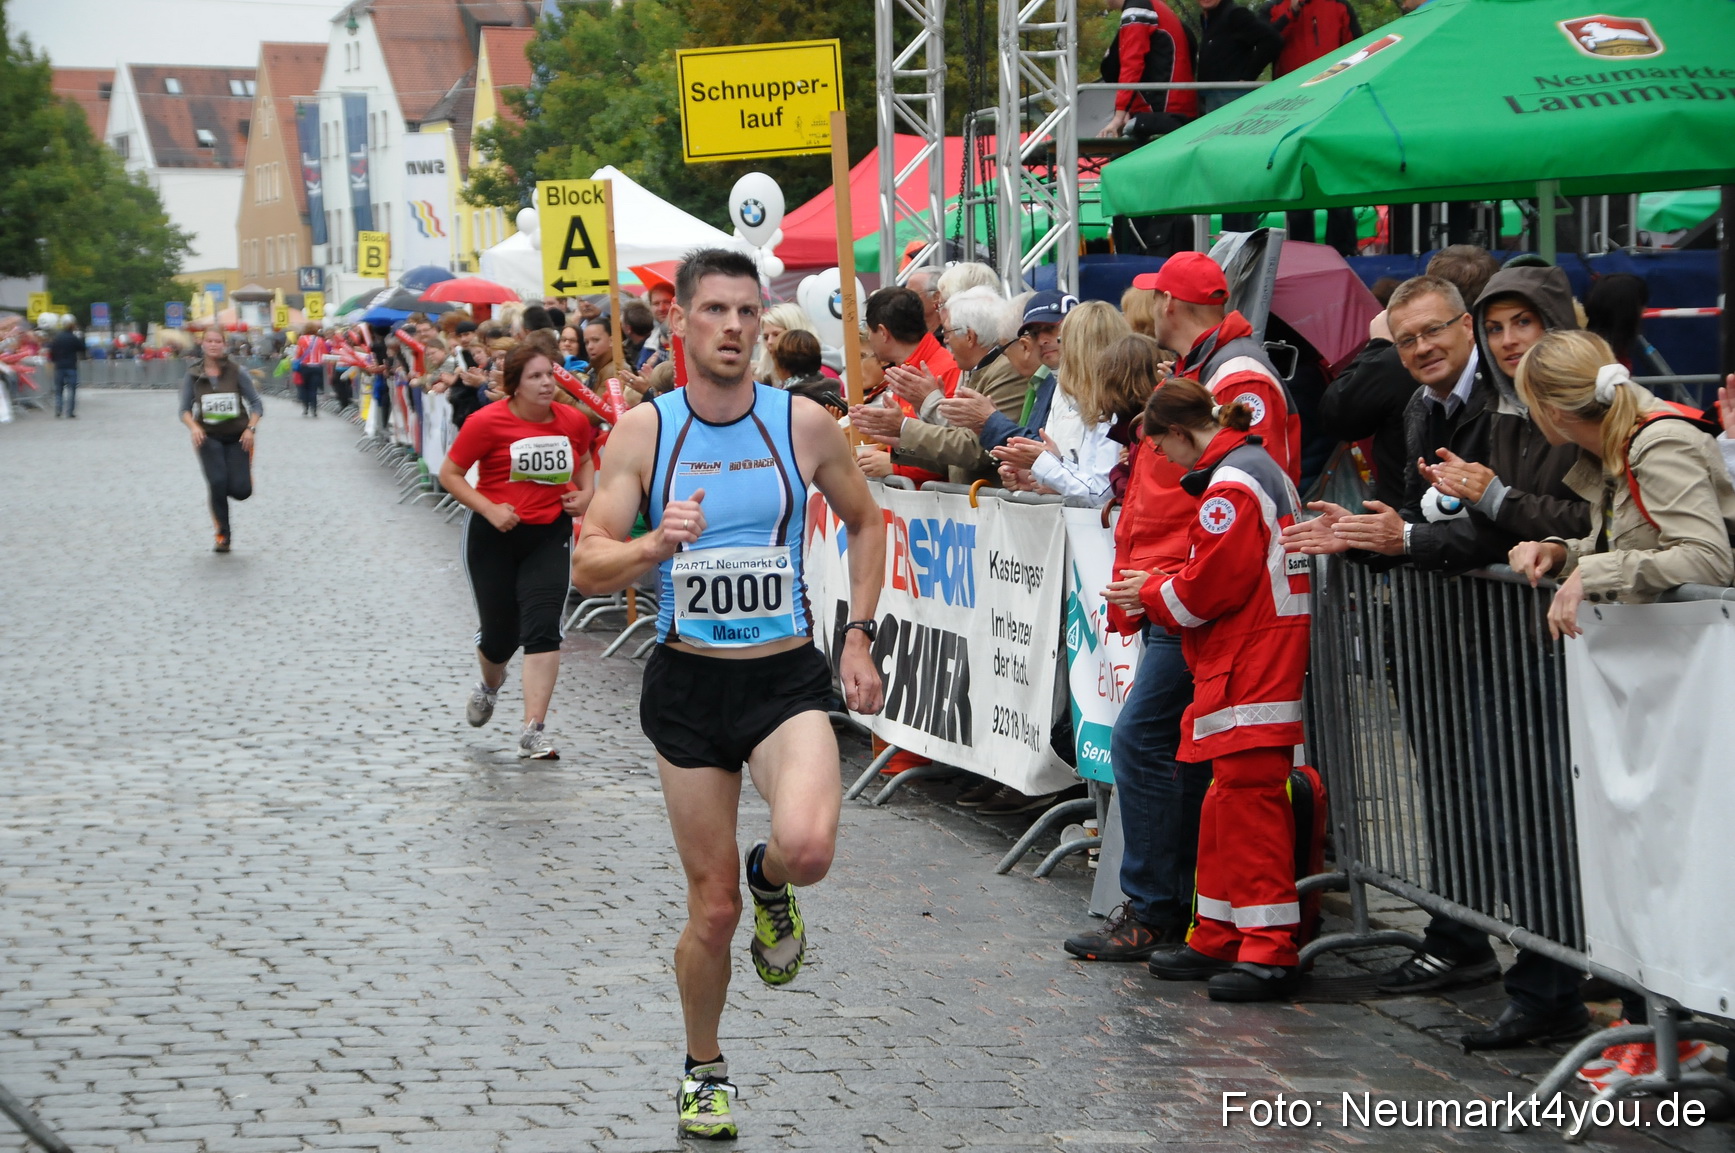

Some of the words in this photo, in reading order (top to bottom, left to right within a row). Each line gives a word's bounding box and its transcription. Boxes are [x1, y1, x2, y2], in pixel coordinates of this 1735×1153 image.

[691, 78, 828, 102] Schnupper-
[740, 106, 783, 129] lauf
[546, 184, 604, 206] Block
[558, 215, 601, 270] A
[366, 246, 381, 268] B
[518, 449, 567, 472] 5058
[675, 560, 713, 571] PARTL
[716, 558, 772, 570] Neumarkt
[686, 572, 782, 615] 2000
[713, 625, 760, 641] Marco
[991, 608, 1005, 638] Im
[994, 648, 1009, 678] der
[993, 704, 1019, 740] 92318
